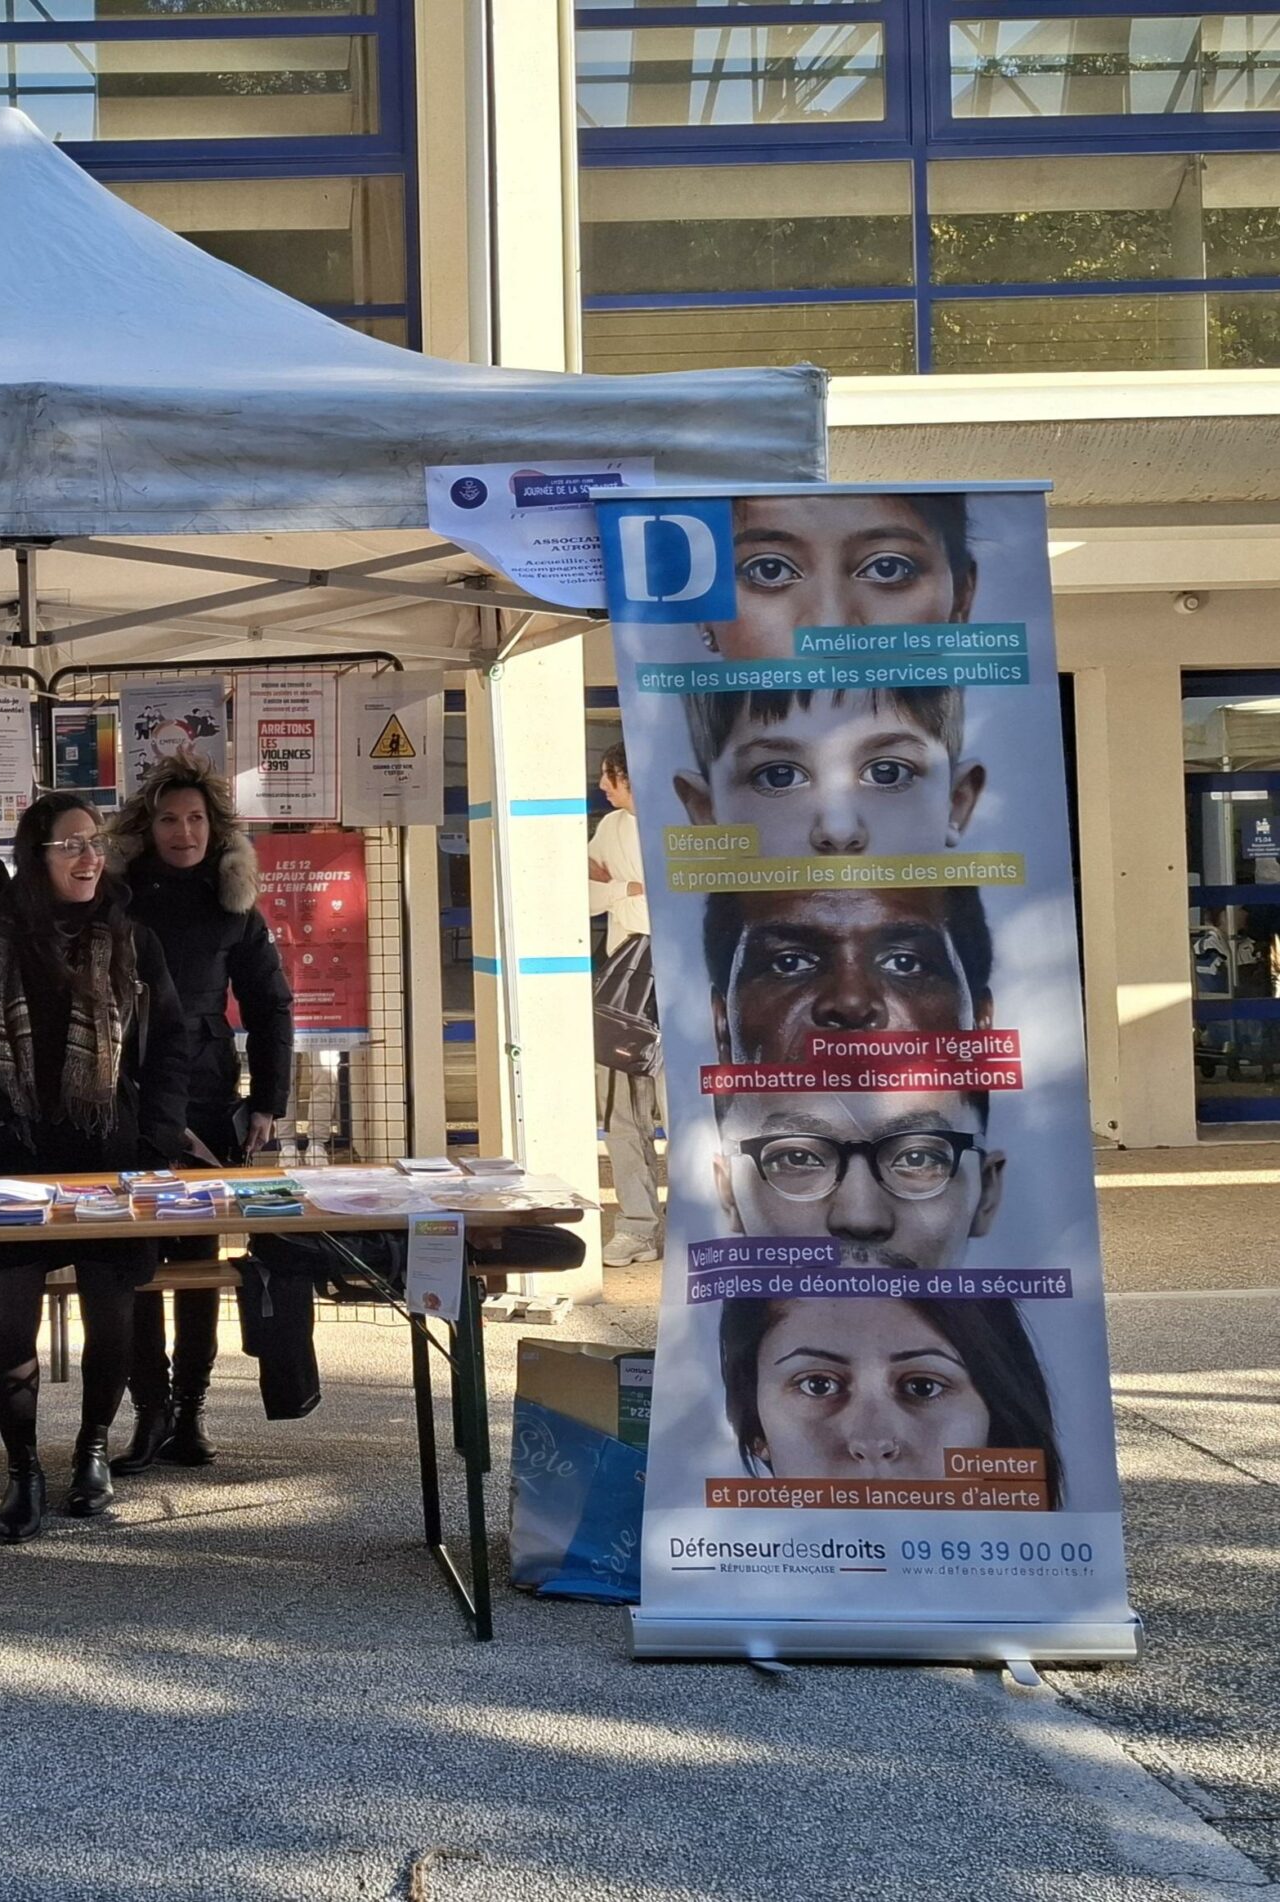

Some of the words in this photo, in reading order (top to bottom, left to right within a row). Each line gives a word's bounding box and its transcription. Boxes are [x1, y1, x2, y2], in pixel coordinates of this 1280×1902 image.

[556, 486, 566, 494] DE
[569, 486, 578, 494] LA
[533, 536, 600, 545] ASSOCIAT
[800, 632, 896, 653] Améliorer
[903, 631, 932, 649] les
[937, 629, 1019, 647] relations
[642, 674, 684, 688] entre
[692, 671, 719, 686] les
[726, 670, 802, 688] usagers
[808, 670, 825, 683] et
[832, 666, 859, 683] les
[866, 665, 947, 680] services
[954, 662, 1021, 681] publics
[261, 722, 312, 734] ARRÊTONS
[261, 739, 277, 748] LES
[261, 750, 311, 759] VIOLENCES
[268, 761, 288, 770] 3919
[669, 833, 750, 851] Défendre
[276, 861, 296, 870] LES
[299, 860, 310, 869] 12
[259, 872, 305, 881] NCIPAUX
[309, 871, 351, 880] DROITS
[672, 872, 687, 886] et
[689, 867, 800, 888] promouvoir
[807, 865, 835, 882] les
[841, 864, 896, 880] droits
[902, 863, 937, 879] des
[945, 862, 1017, 879] enfants
[260, 884, 274, 892] DE
[277, 883, 328, 892] L'ENFANT
[813, 1038, 929, 1055] Promouvoir
[935, 1037, 1014, 1059] l'égalité
[703, 1075, 713, 1089] et
[715, 1071, 816, 1088] combattre
[822, 1071, 852, 1087] les
[858, 1066, 1016, 1087] discriminations
[691, 1246, 723, 1267] Veiller
[728, 1247, 750, 1261] au
[756, 1245, 834, 1265] respect
[691, 1282, 712, 1299] des
[714, 1276, 763, 1297] règles
[769, 1274, 793, 1293] de
[799, 1273, 920, 1299] déontologie
[927, 1276, 952, 1293] de
[958, 1275, 976, 1293] la
[981, 1275, 1067, 1295] sécurité
[951, 1454, 1037, 1474] Orienter
[712, 1486, 731, 1503] et
[737, 1484, 823, 1509] protéger
[830, 1485, 860, 1505] les
[866, 1485, 956, 1506] lanceurs
[961, 1486, 1040, 1506] d'alerte
[670, 1537, 885, 1559] Défenseurdesdroits
[902, 1540, 931, 1560] 09
[942, 1541, 970, 1561] 69
[980, 1541, 1009, 1561] 39
[1020, 1542, 1051, 1562] 00
[1061, 1543, 1092, 1562] 00
[720, 1563, 780, 1573] RÉPUBLIQUE
[783, 1564, 835, 1575] FRANÇAISE
[902, 1566, 1094, 1576] www.defenseurdesdroits.fr
